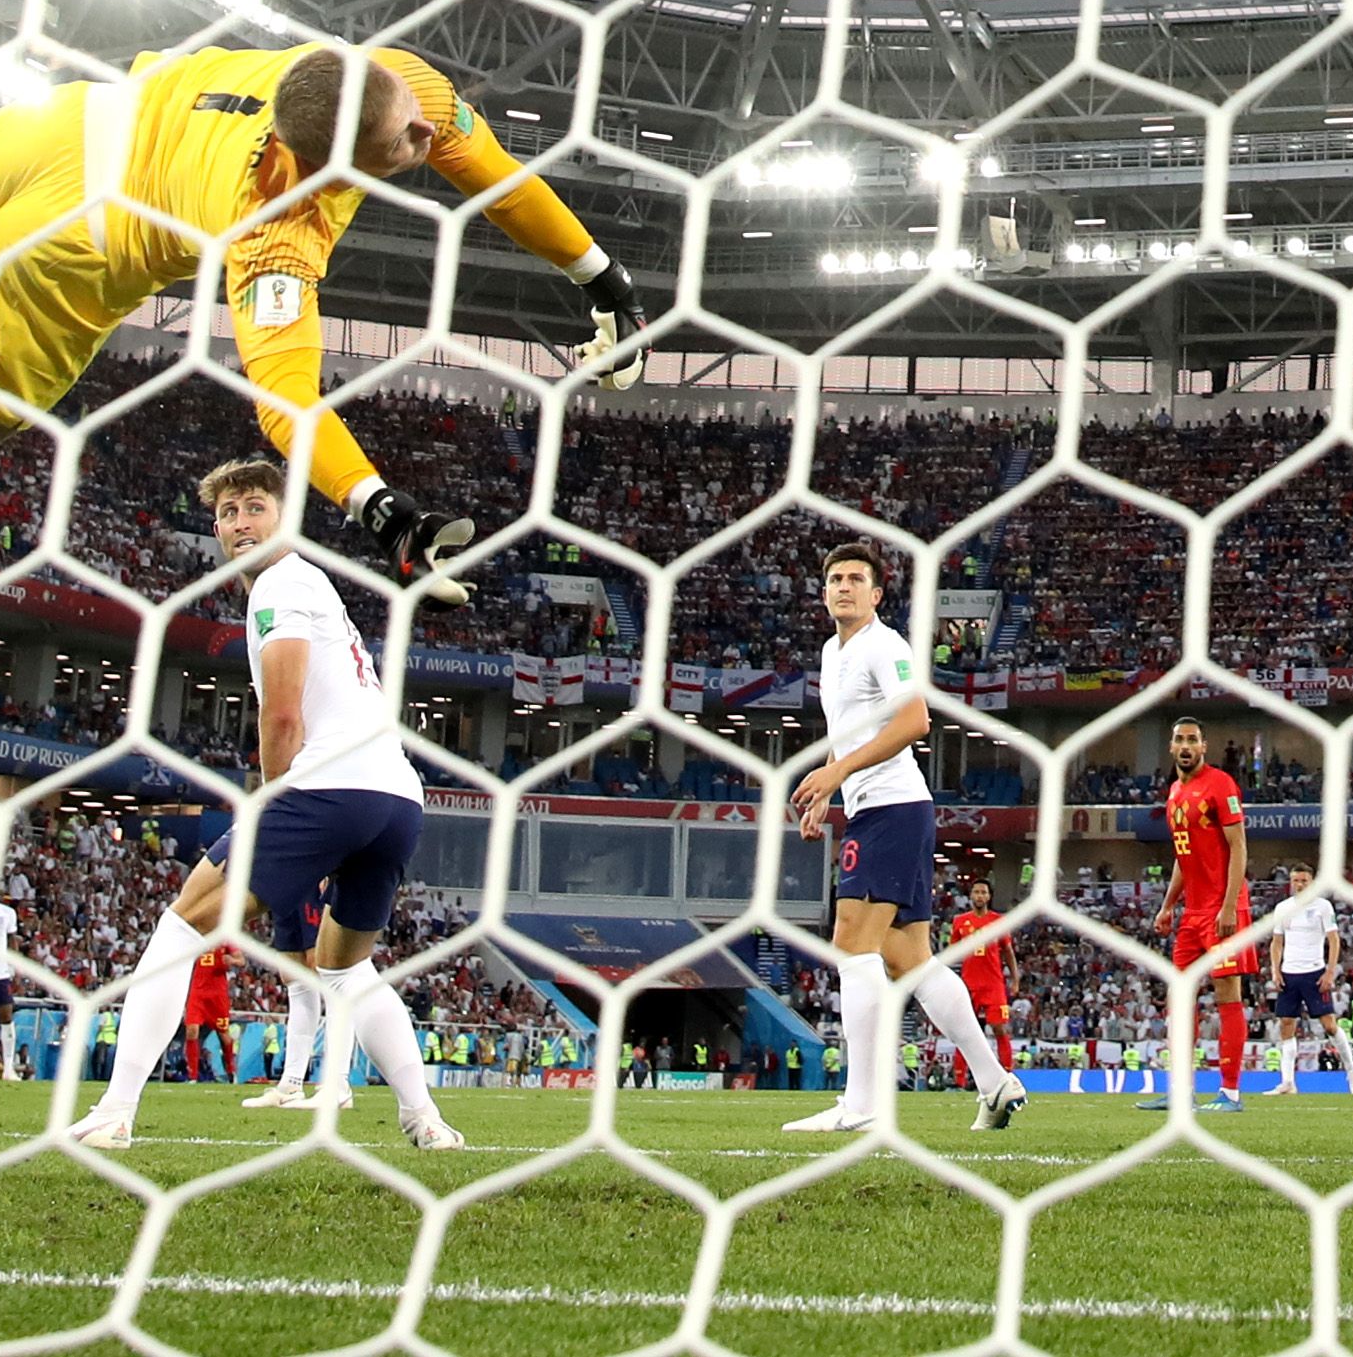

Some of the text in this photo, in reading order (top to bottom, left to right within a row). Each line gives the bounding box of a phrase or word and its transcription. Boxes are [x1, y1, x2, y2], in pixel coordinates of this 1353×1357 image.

[425, 657, 471, 675] МИРА
[477, 661, 499, 677] ПО
[1255, 668, 1276, 681] 56
[12, 742, 37, 763] CUP
[1173, 831, 1191, 855] 22
[842, 839, 860, 872] 6
[656, 1071, 705, 1090] Hisense
